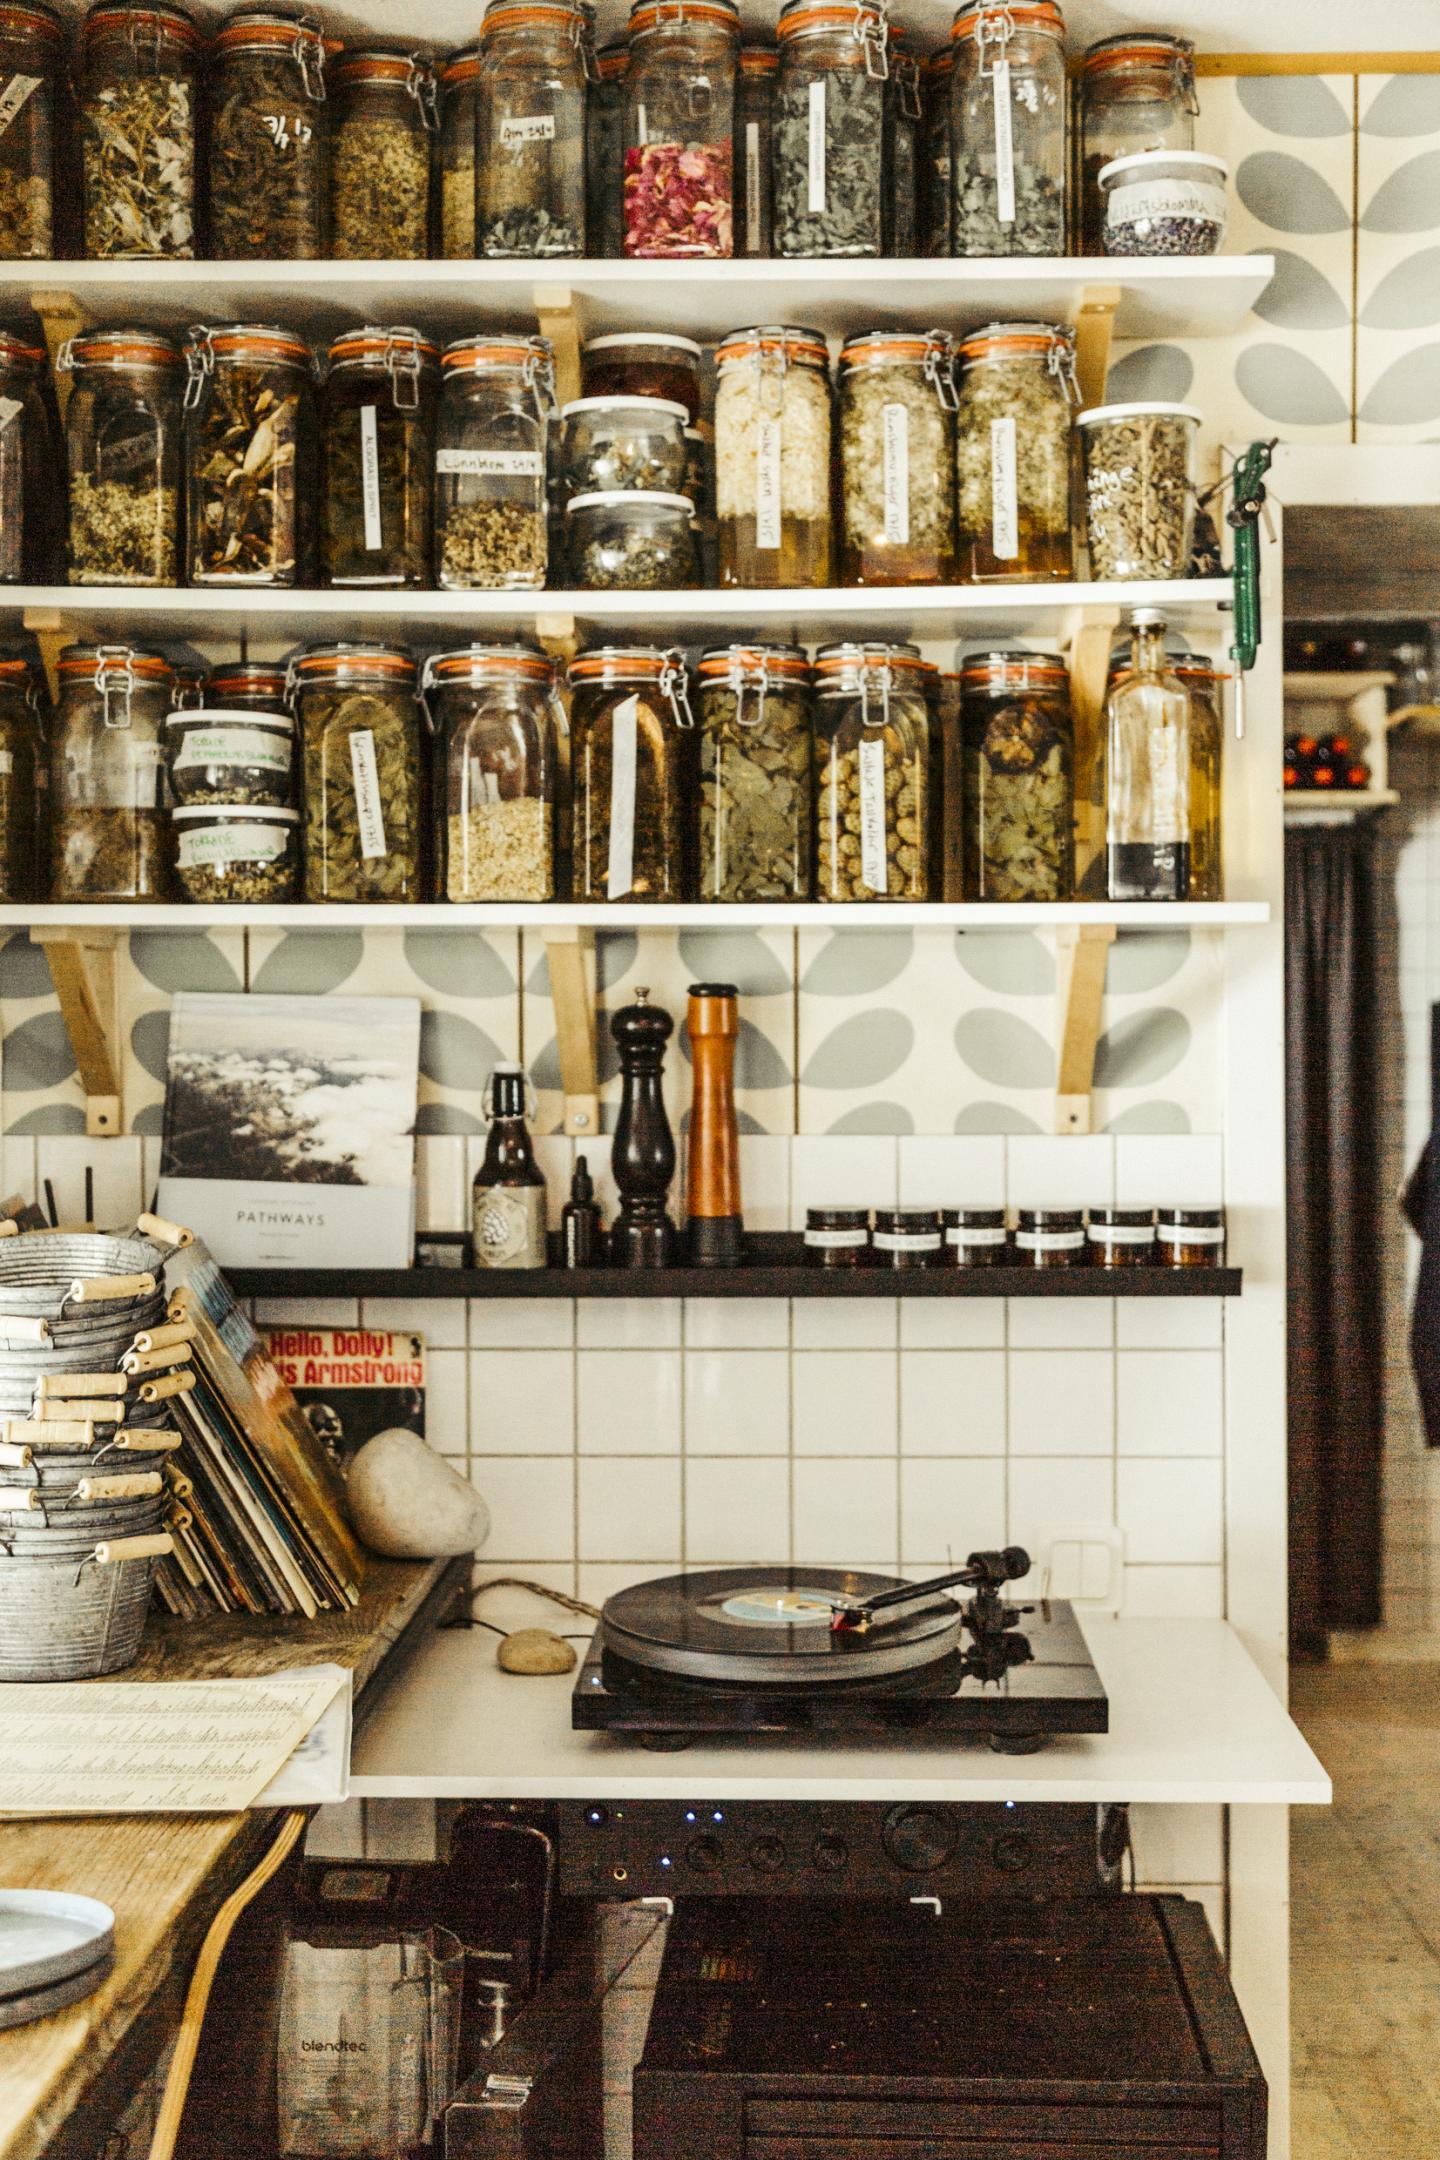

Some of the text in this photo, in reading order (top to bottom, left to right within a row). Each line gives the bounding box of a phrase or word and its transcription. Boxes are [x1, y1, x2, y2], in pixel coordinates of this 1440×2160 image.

[236, 1210, 325, 1226] PATHWAYS
[270, 1331, 393, 1358] Hello, Dolly!
[303, 1360, 423, 1386] Armstrong
[301, 2040, 368, 2053] blendtec
